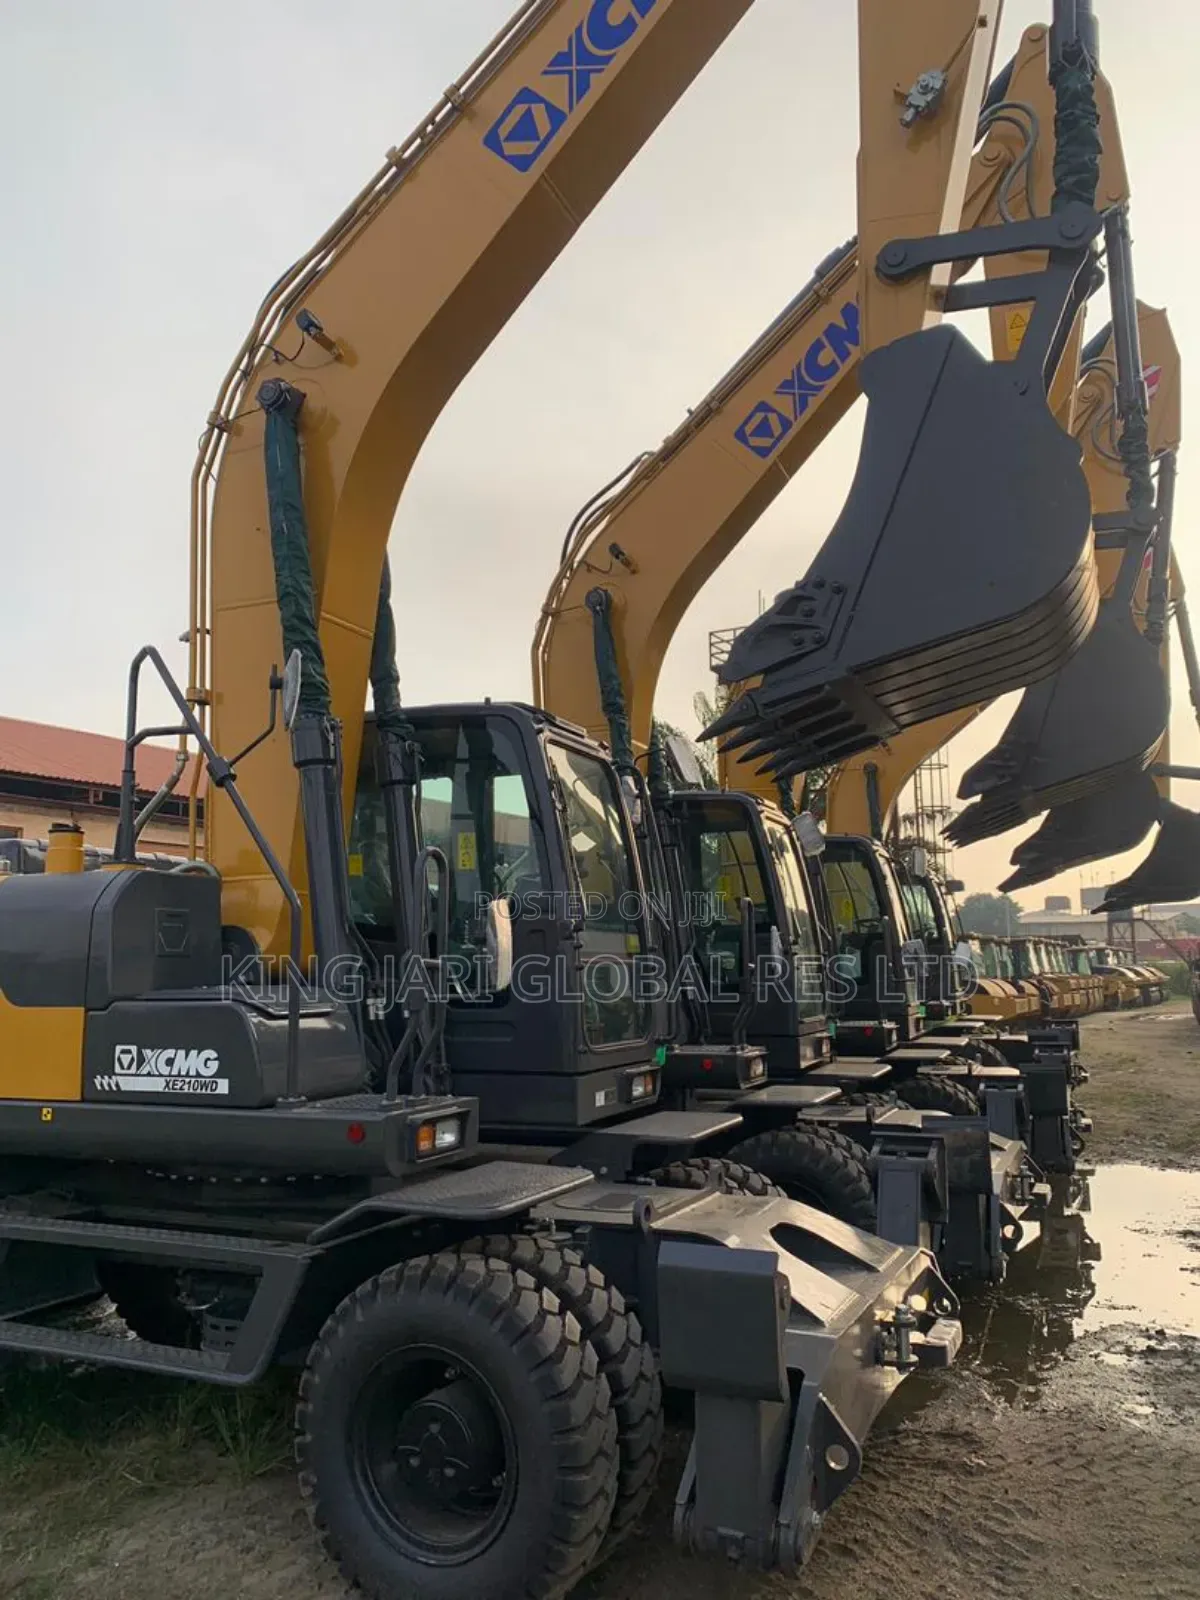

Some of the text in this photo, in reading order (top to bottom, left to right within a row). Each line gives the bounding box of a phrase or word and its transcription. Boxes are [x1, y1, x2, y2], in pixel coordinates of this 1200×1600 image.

[540, 0, 657, 115] XC
[774, 301, 860, 421] XCM
[136, 1048, 220, 1077] XCMG
[163, 1079, 219, 1093] XE210WD
